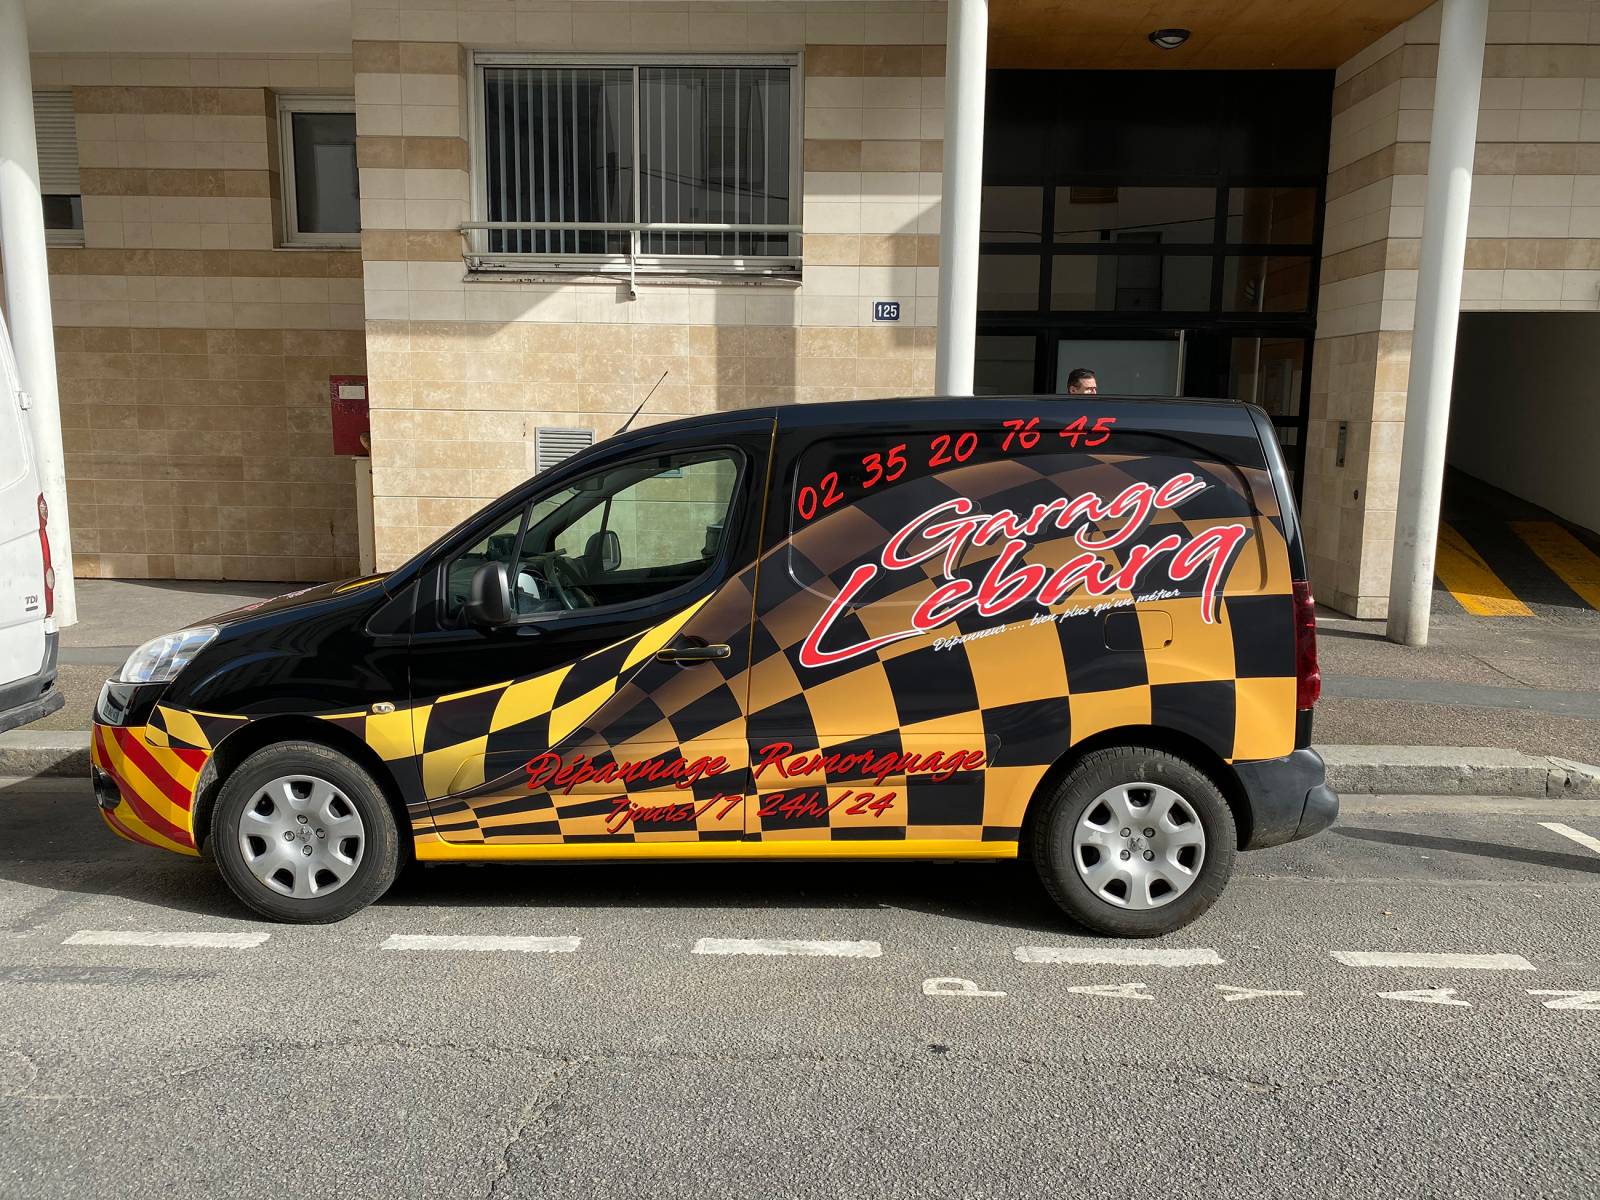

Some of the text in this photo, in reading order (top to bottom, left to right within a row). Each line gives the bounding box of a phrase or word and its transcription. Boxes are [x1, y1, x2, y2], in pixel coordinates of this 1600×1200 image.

[877, 304, 897, 318] 125
[798, 416, 1117, 520] 02 35 20 76 45
[880, 472, 1207, 580] Garage
[25, 595, 38, 604] TDI
[799, 523, 1246, 669] Lebarq
[1030, 612, 1059, 627] bien
[1060, 602, 1091, 623] plus
[1092, 597, 1135, 616] qu'un
[1136, 588, 1180, 604] métier
[525, 742, 988, 796] Dépannage Remorquage
